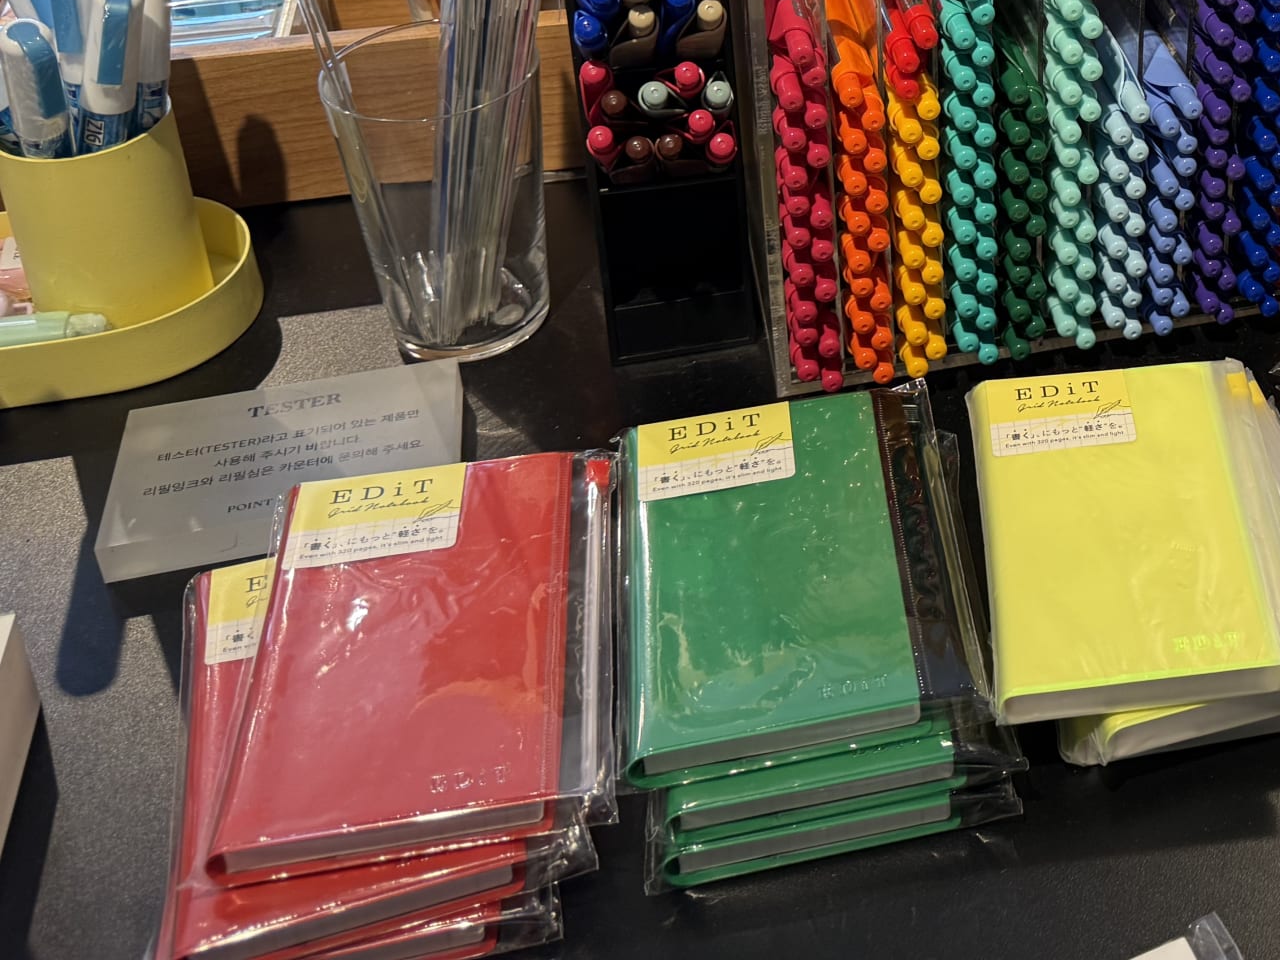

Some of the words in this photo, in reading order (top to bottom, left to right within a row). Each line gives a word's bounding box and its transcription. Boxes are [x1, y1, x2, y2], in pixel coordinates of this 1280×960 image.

[86, 121, 102, 145] ZIG
[1014, 381, 1099, 401] EDiT
[248, 392, 342, 418] TESTER
[1018, 402, 1045, 413] Grid
[1048, 396, 1101, 408] Notebook
[157, 431, 288, 463] 테스터(TESTER)라고
[295, 422, 346, 440] 표기되어
[350, 416, 376, 430] 있는
[381, 408, 420, 425] 제품만
[668, 413, 760, 441] EDiT
[1110, 430, 1124, 438] light
[670, 441, 700, 454] Grid
[703, 430, 760, 447] Notebook
[214, 451, 256, 470] 사용해
[260, 444, 301, 462] 주시기
[143, 475, 213, 498] 리필잉크와
[218, 466, 275, 485] 리필심은
[279, 456, 333, 474] 카운터에
[766, 466, 782, 474] light
[329, 478, 434, 505] EDiT
[227, 498, 275, 514] POINT
[364, 497, 430, 512] Notebook
